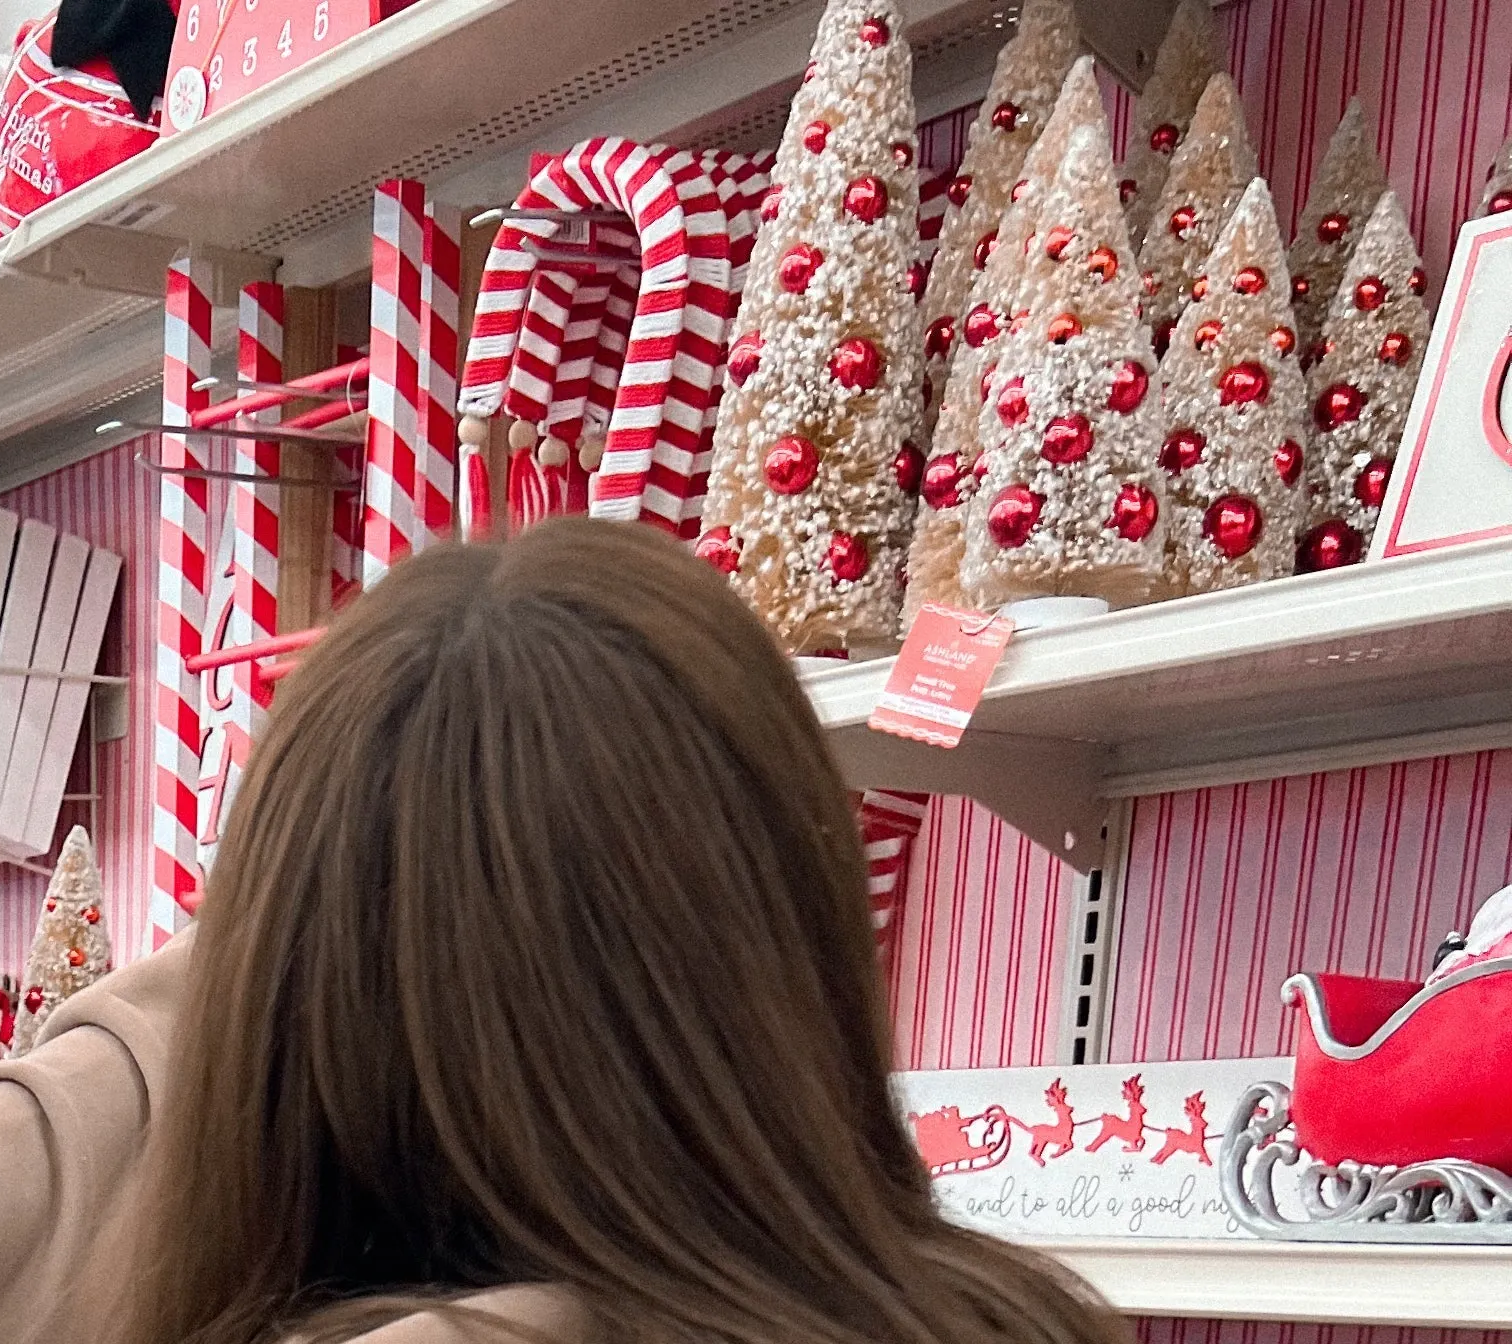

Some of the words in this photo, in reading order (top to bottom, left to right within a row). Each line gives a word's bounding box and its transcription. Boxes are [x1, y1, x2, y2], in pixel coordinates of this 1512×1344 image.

[187, 4, 199, 42] 6
[208, 54, 223, 93] 2
[242, 36, 258, 76] 3
[277, 18, 292, 58] 4
[313, 0, 329, 42] 5
[966, 1176, 1015, 1218] and
[1021, 1188, 1048, 1218] to
[1056, 1175, 1101, 1218] all
[1106, 1196, 1123, 1217] a
[1128, 1175, 1196, 1233] good
